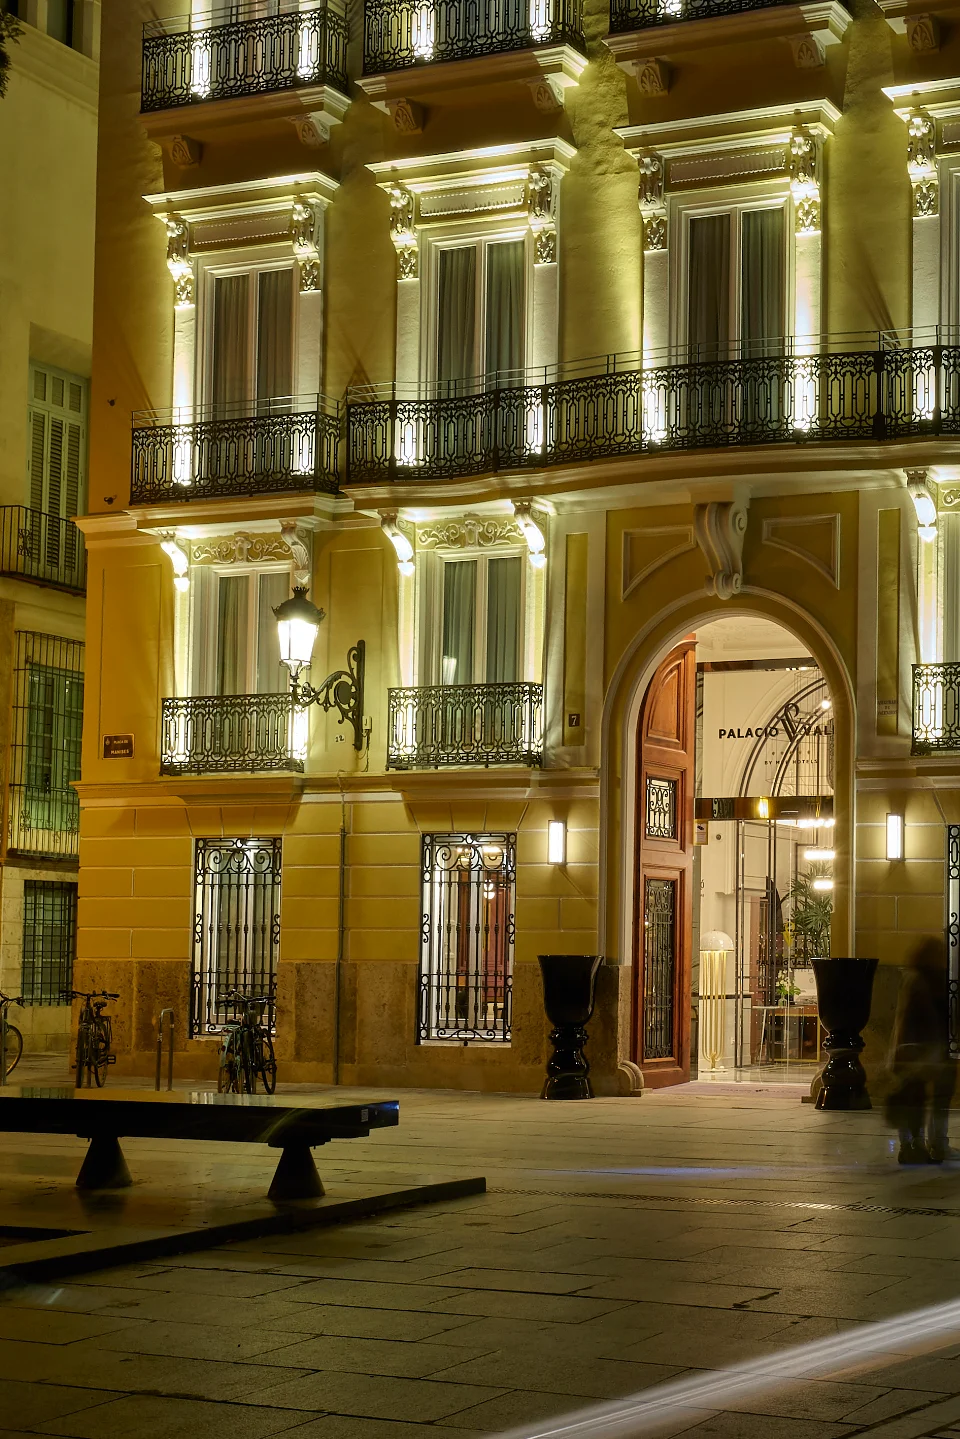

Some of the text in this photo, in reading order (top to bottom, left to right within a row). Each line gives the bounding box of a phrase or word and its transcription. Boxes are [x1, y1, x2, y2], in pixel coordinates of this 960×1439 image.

[571, 715, 577, 726] 7
[718, 727, 779, 739] PALACIO
[335, 735, 345, 743] 12
